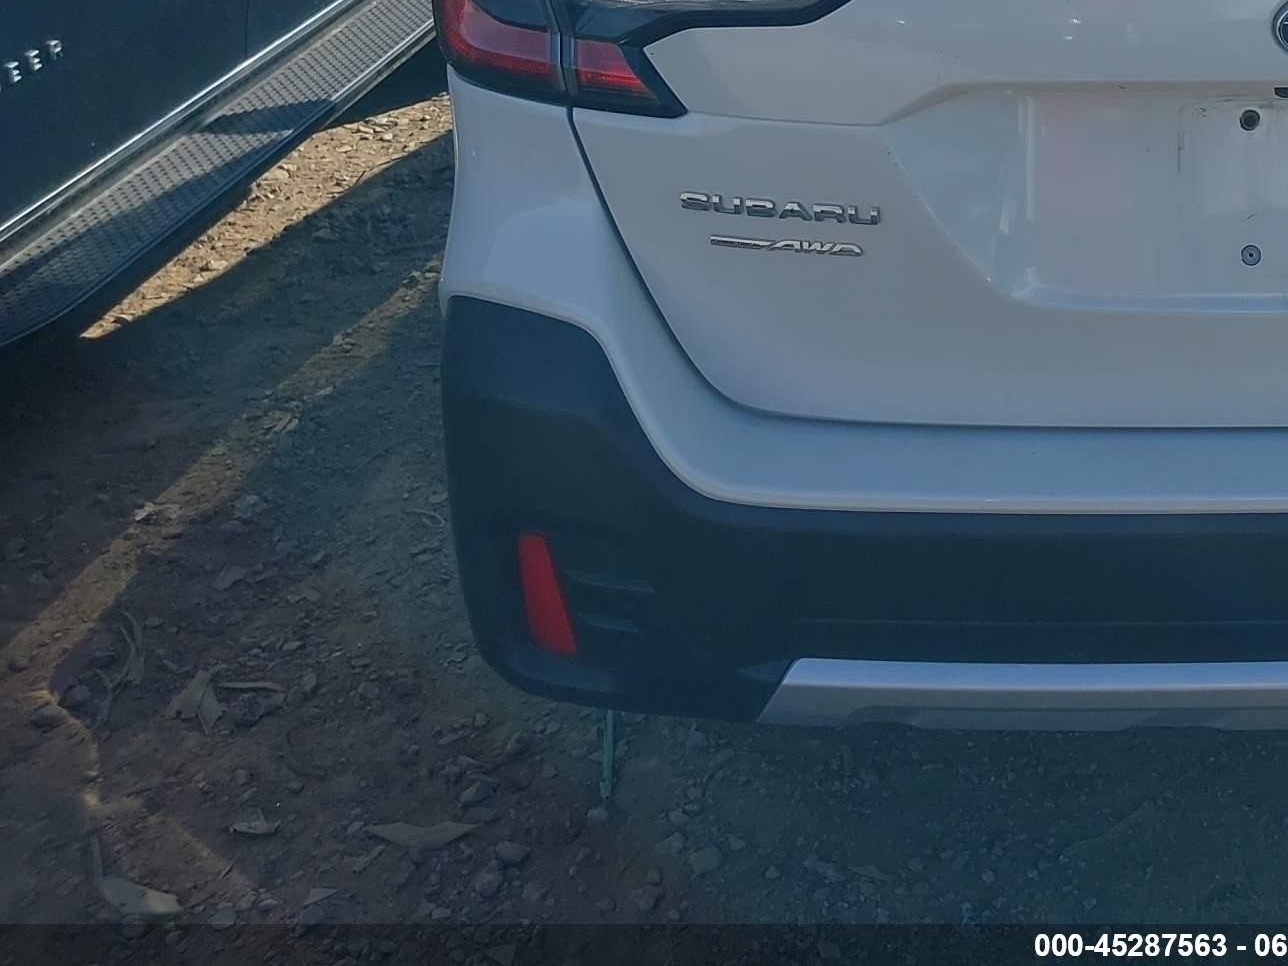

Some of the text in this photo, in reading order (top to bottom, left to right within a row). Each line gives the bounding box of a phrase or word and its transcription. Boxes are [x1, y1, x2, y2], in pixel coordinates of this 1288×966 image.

[0, 40, 64, 90] EER
[680, 191, 881, 226] SUBARU
[767, 239, 865, 257] AWD
